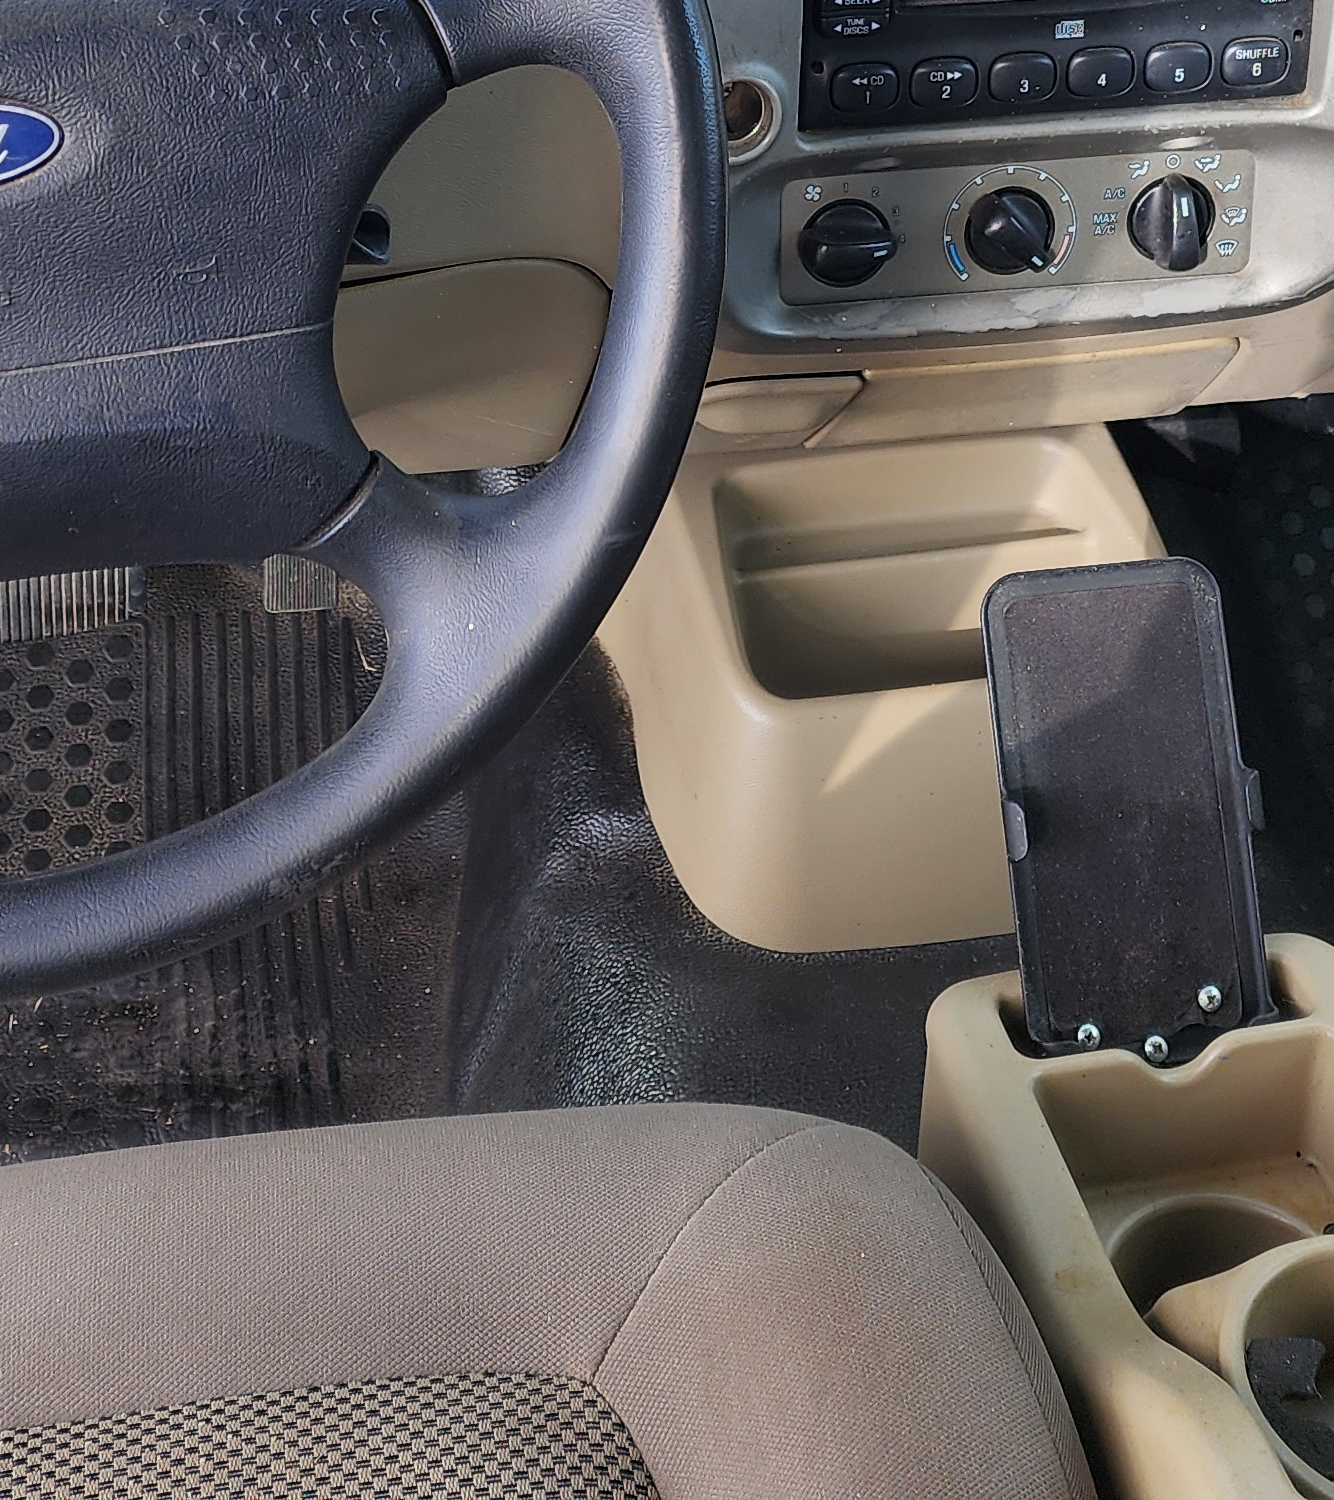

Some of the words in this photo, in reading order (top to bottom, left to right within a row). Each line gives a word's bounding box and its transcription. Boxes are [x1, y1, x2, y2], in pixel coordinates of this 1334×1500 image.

[843, 26, 869, 35] DISCS
[1235, 47, 1280, 60] SHUFFLE
[1252, 63, 1262, 76] 6
[870, 76, 884, 85] CD
[930, 72, 945, 82] CD
[1097, 73, 1107, 86] 4
[1174, 68, 1185, 83] 5
[942, 85, 951, 99] 2
[1019, 80, 1029, 93] 3
[872, 187, 878, 197] 2
[1104, 188, 1125, 199] A/C
[892, 207, 899, 215] 3
[1093, 213, 1117, 223] MAX
[1094, 225, 1115, 236] A/C
